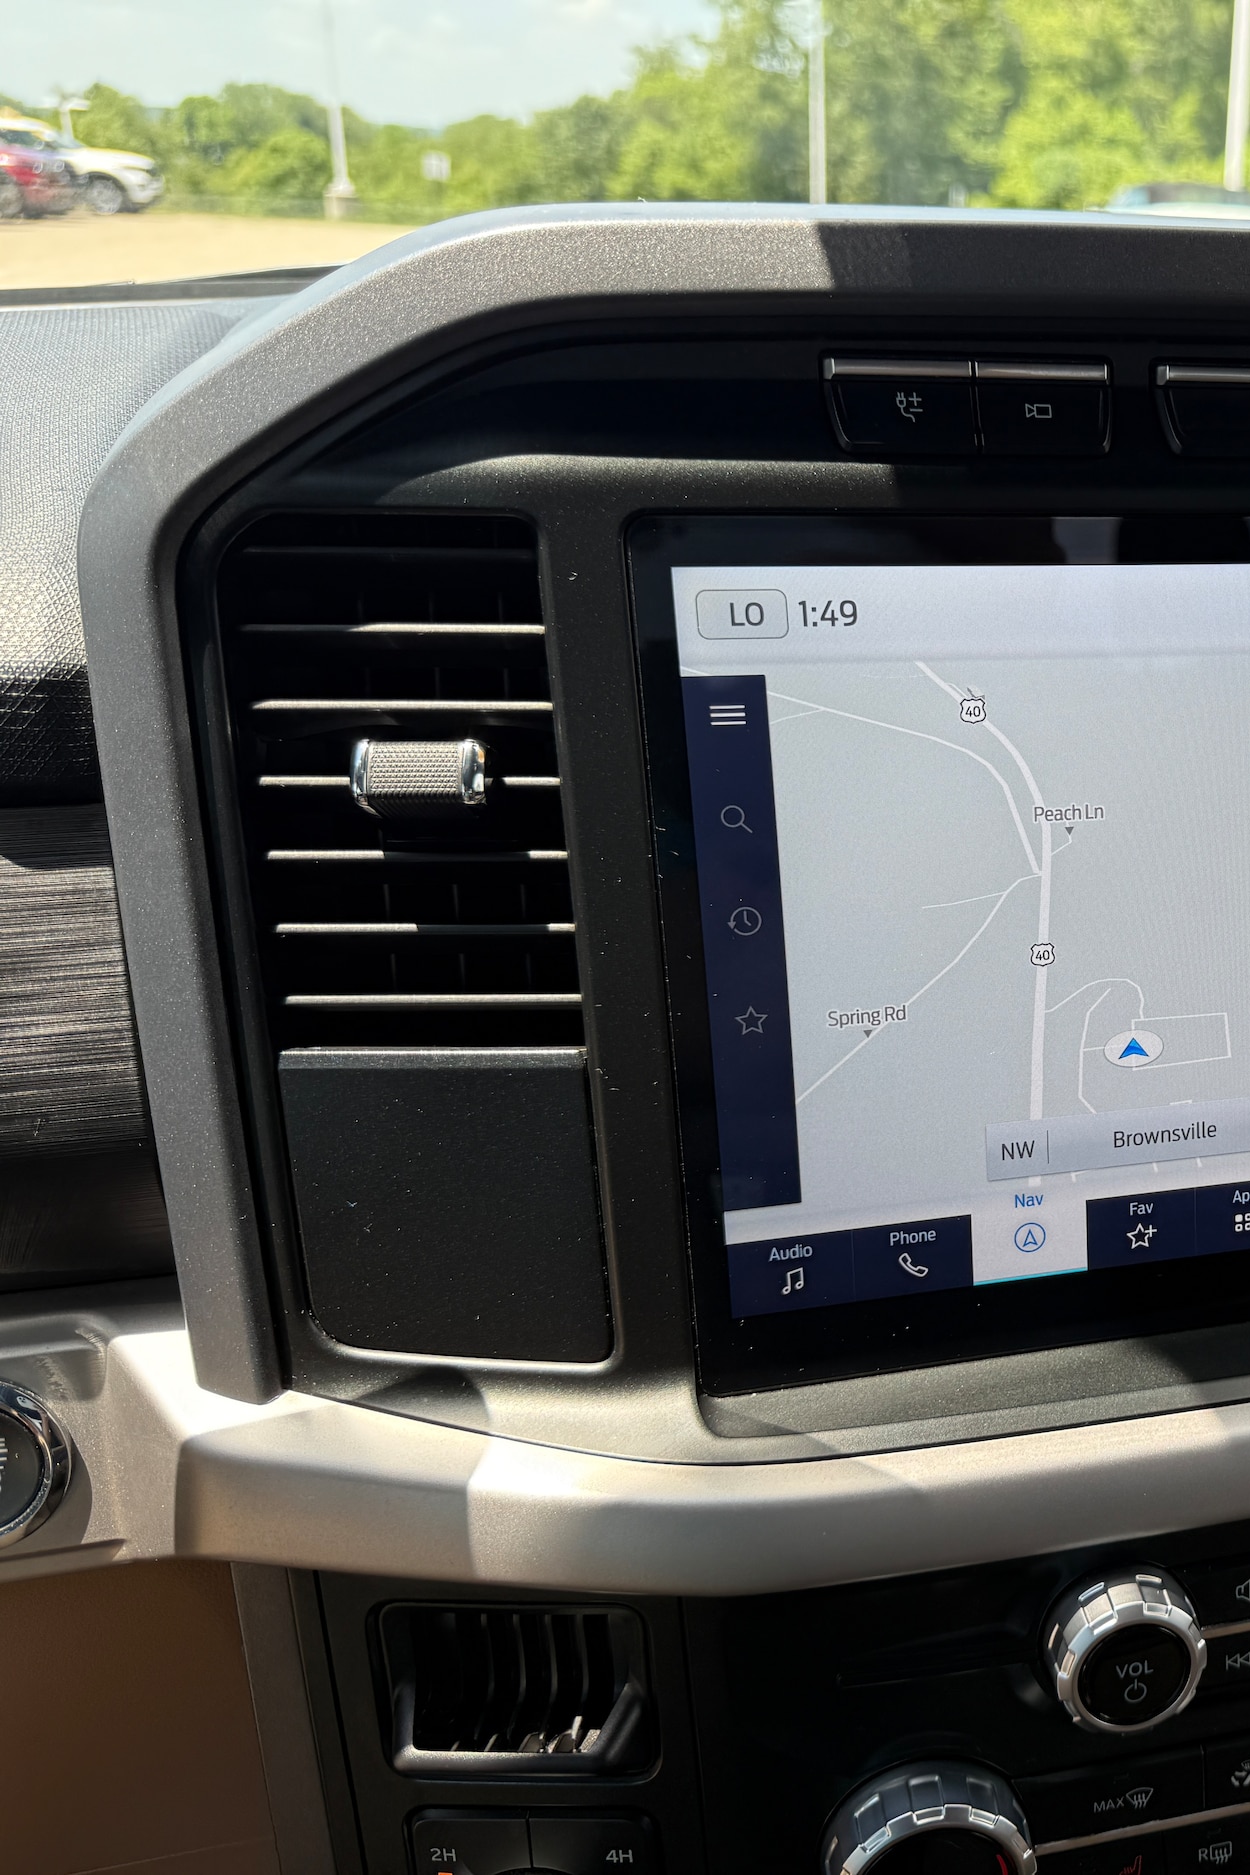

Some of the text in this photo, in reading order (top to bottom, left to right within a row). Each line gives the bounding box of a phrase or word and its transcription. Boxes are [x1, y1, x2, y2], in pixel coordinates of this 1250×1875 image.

[729, 602, 764, 627] LO
[799, 600, 858, 627] 1:49
[965, 705, 982, 719] 40
[1034, 804, 1104, 822] Peach Ln
[1035, 949, 1050, 962] 40
[827, 1004, 907, 1028] Spring Rd
[1113, 1121, 1217, 1149] Brownsville
[1001, 1141, 1035, 1161] NW
[1014, 1192, 1043, 1208] Nav
[1129, 1201, 1153, 1216] Fav
[889, 1227, 936, 1246] Phone
[769, 1243, 813, 1261] Audio
[1116, 1659, 1153, 1679] VOL
[1093, 1797, 1124, 1813] MAX
[430, 1848, 456, 1862] 2H
[606, 1849, 633, 1863] 4H
[1199, 1849, 1208, 1862] R
